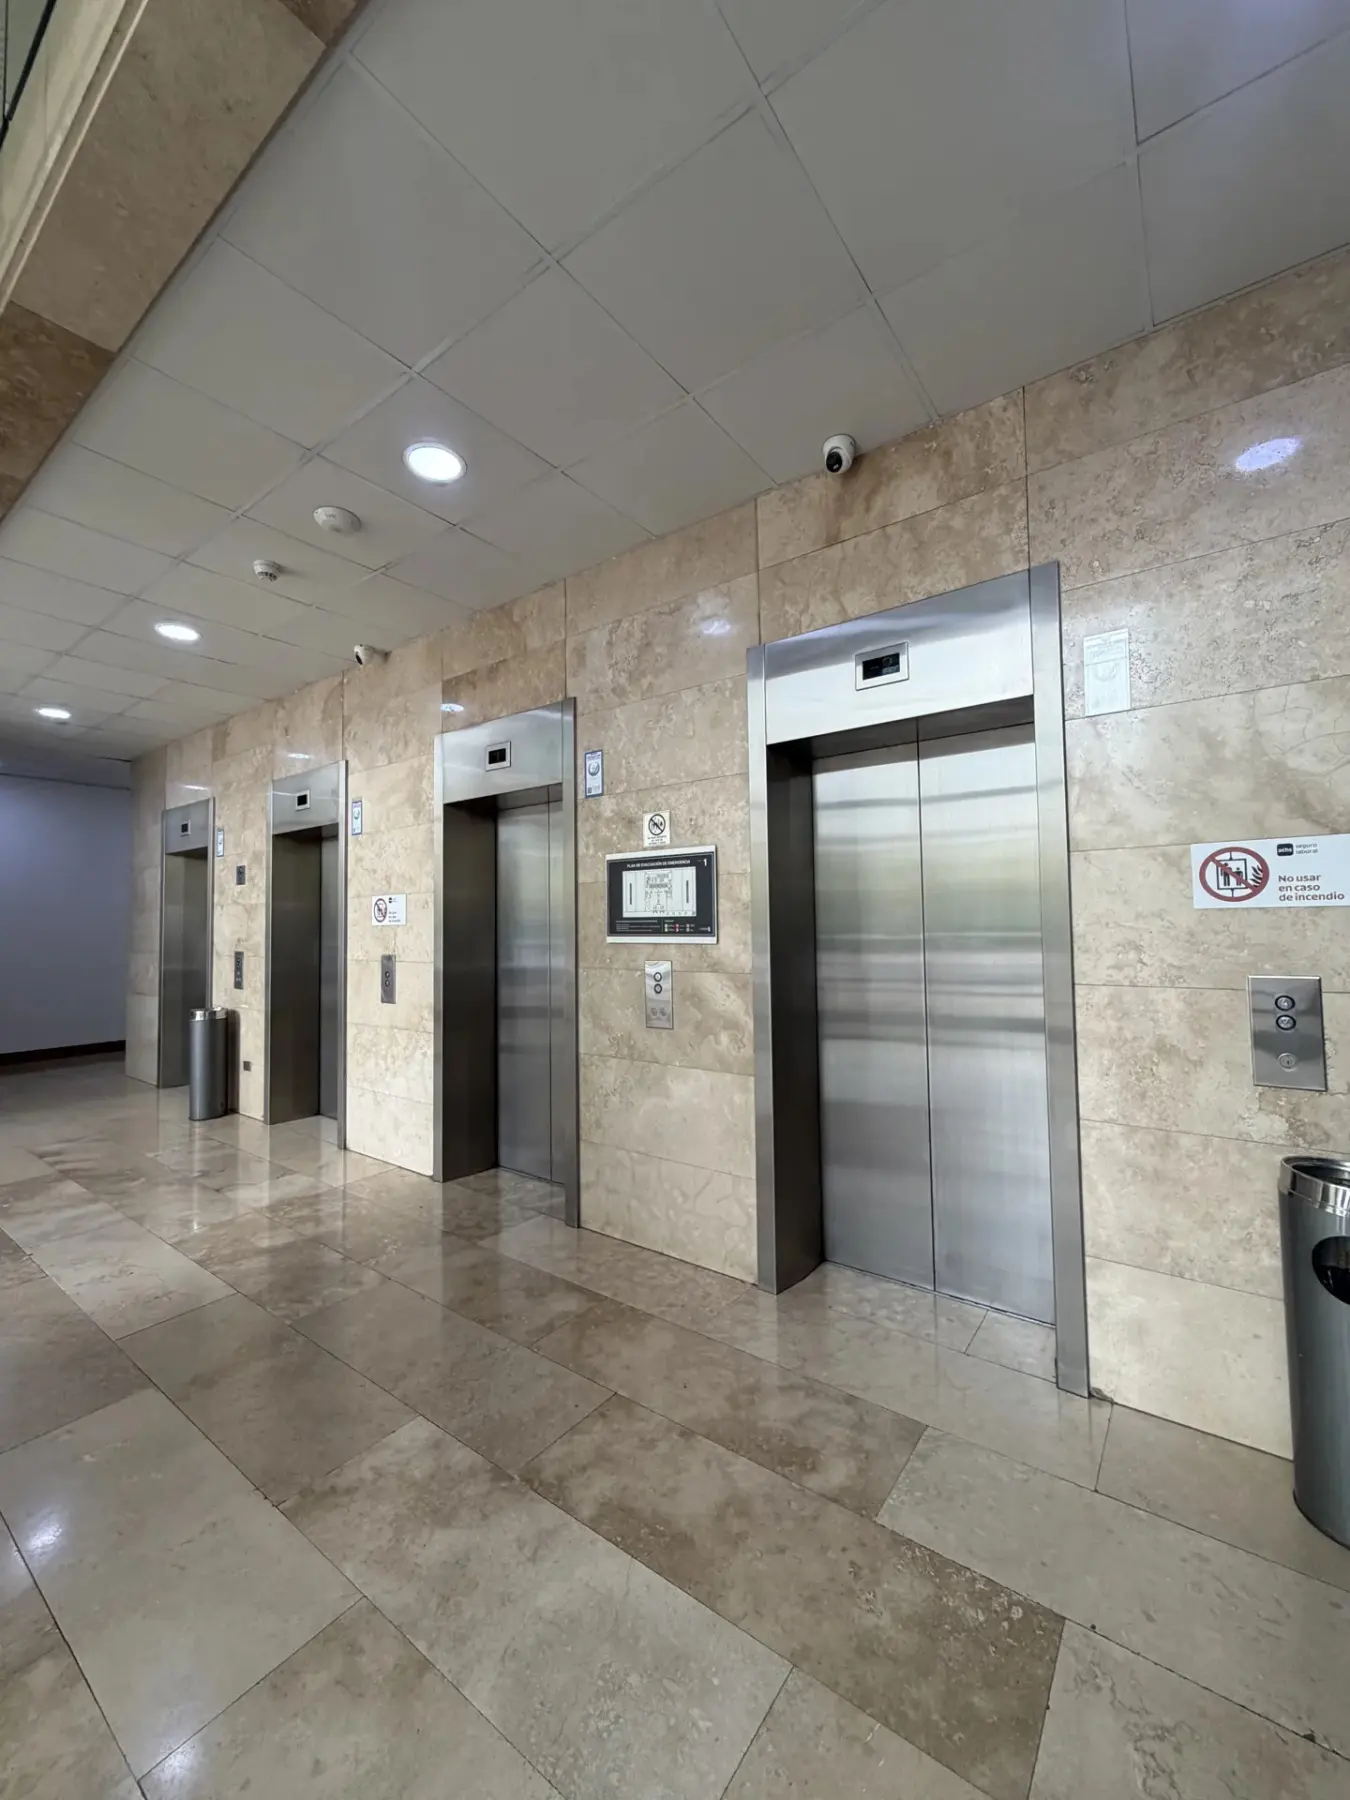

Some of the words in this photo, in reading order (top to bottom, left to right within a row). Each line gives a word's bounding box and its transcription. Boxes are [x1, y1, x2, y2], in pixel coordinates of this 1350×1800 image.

[703, 858, 708, 866] 1
[1279, 893, 1293, 901] de
[1295, 891, 1345, 901] incendio
